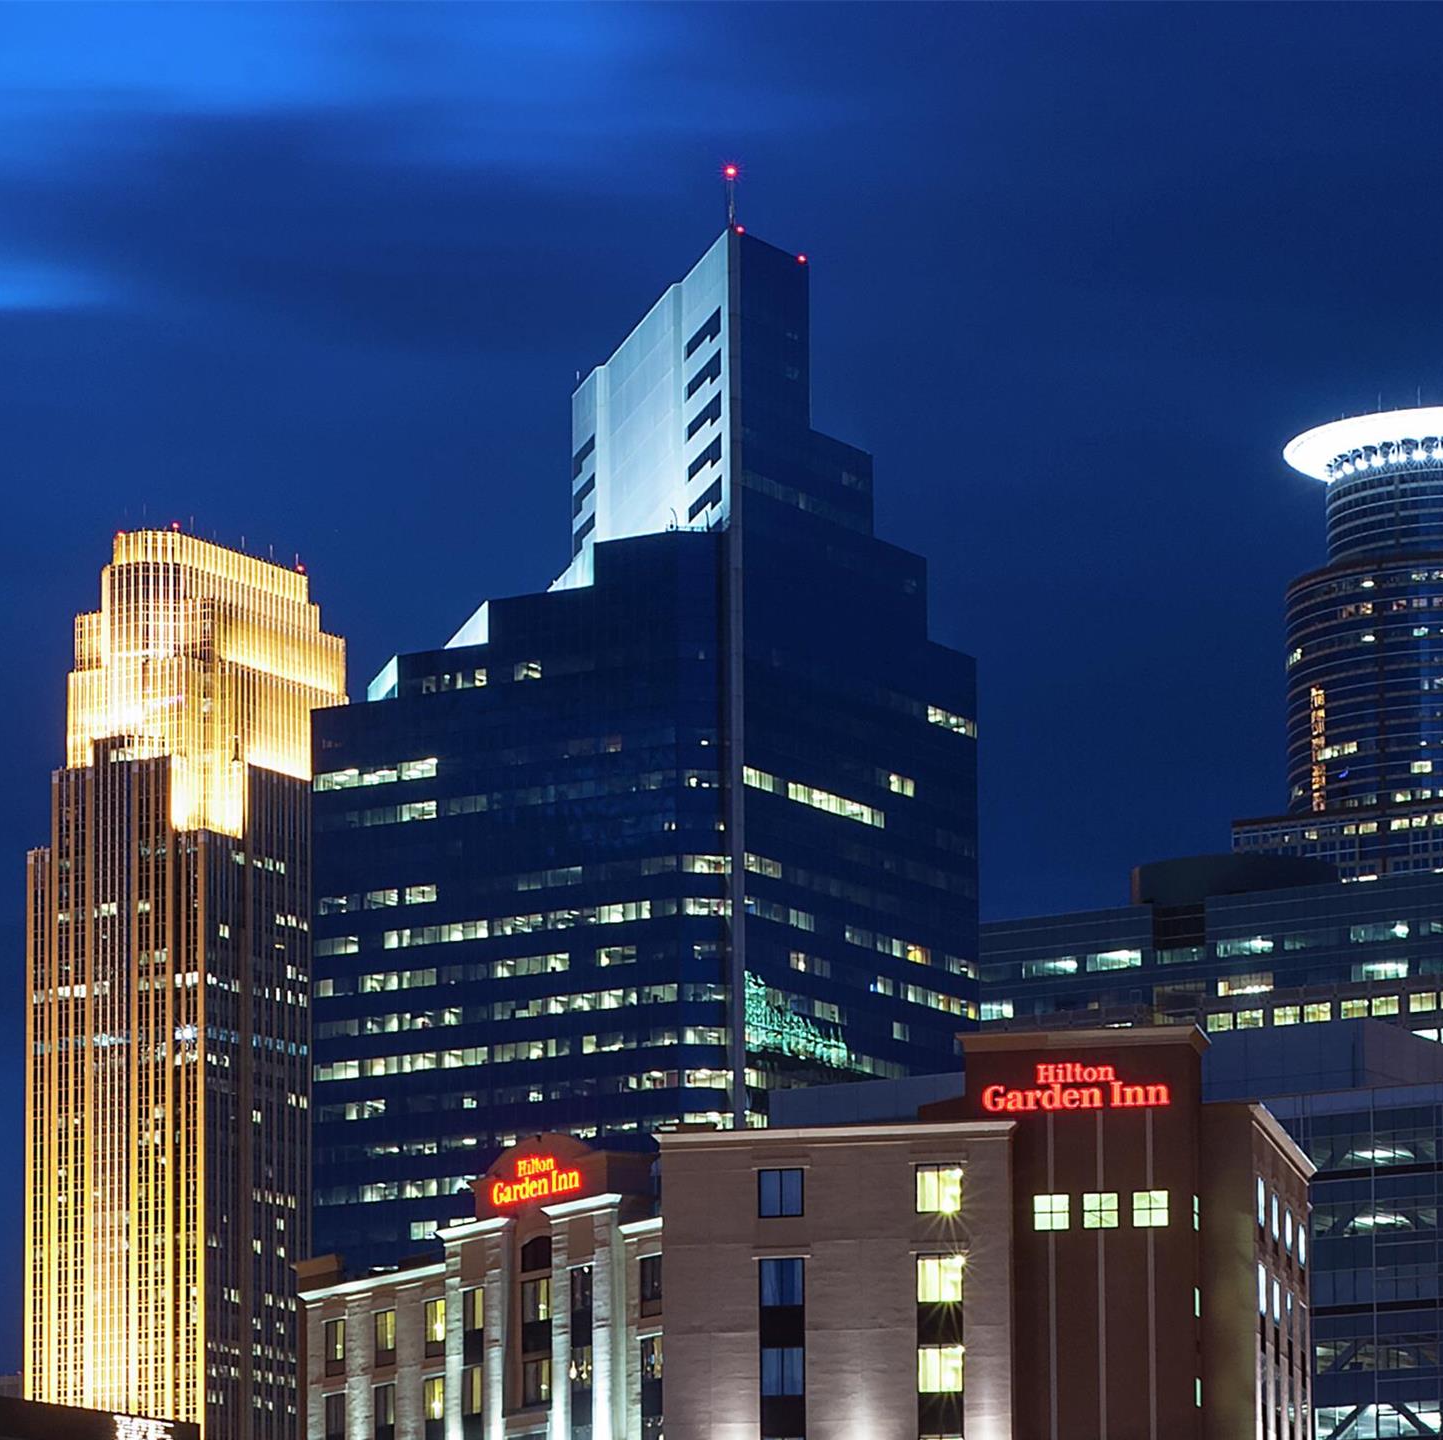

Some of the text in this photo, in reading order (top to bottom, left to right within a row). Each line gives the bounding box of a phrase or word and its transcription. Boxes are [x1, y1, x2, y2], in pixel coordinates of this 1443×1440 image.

[1036, 1063, 1115, 1084] Hilton
[982, 1081, 1170, 1112] Garden Inn
[516, 1157, 555, 1177] Hilton
[492, 1169, 580, 1205] Garden Inn
